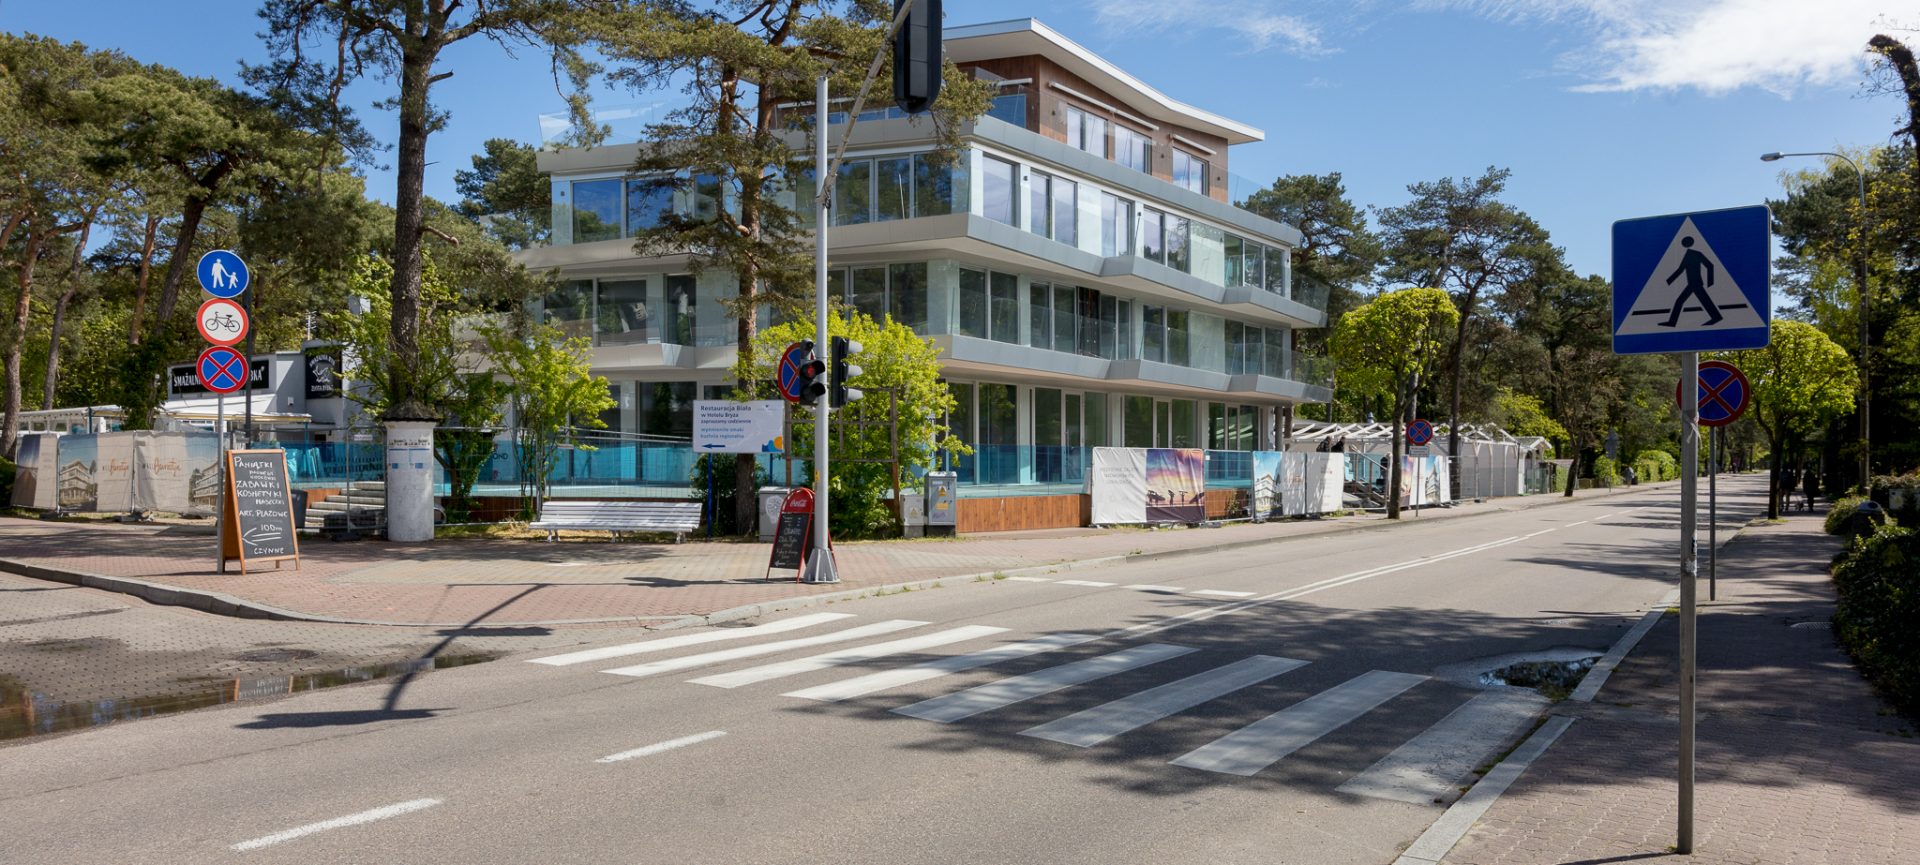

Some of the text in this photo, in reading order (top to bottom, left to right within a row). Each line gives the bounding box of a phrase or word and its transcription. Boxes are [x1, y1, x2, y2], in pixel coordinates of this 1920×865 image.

[700, 405, 735, 413] Restauracja
[237, 480, 280, 489] ZABAWKI
[254, 547, 284, 555] CZYNNE
